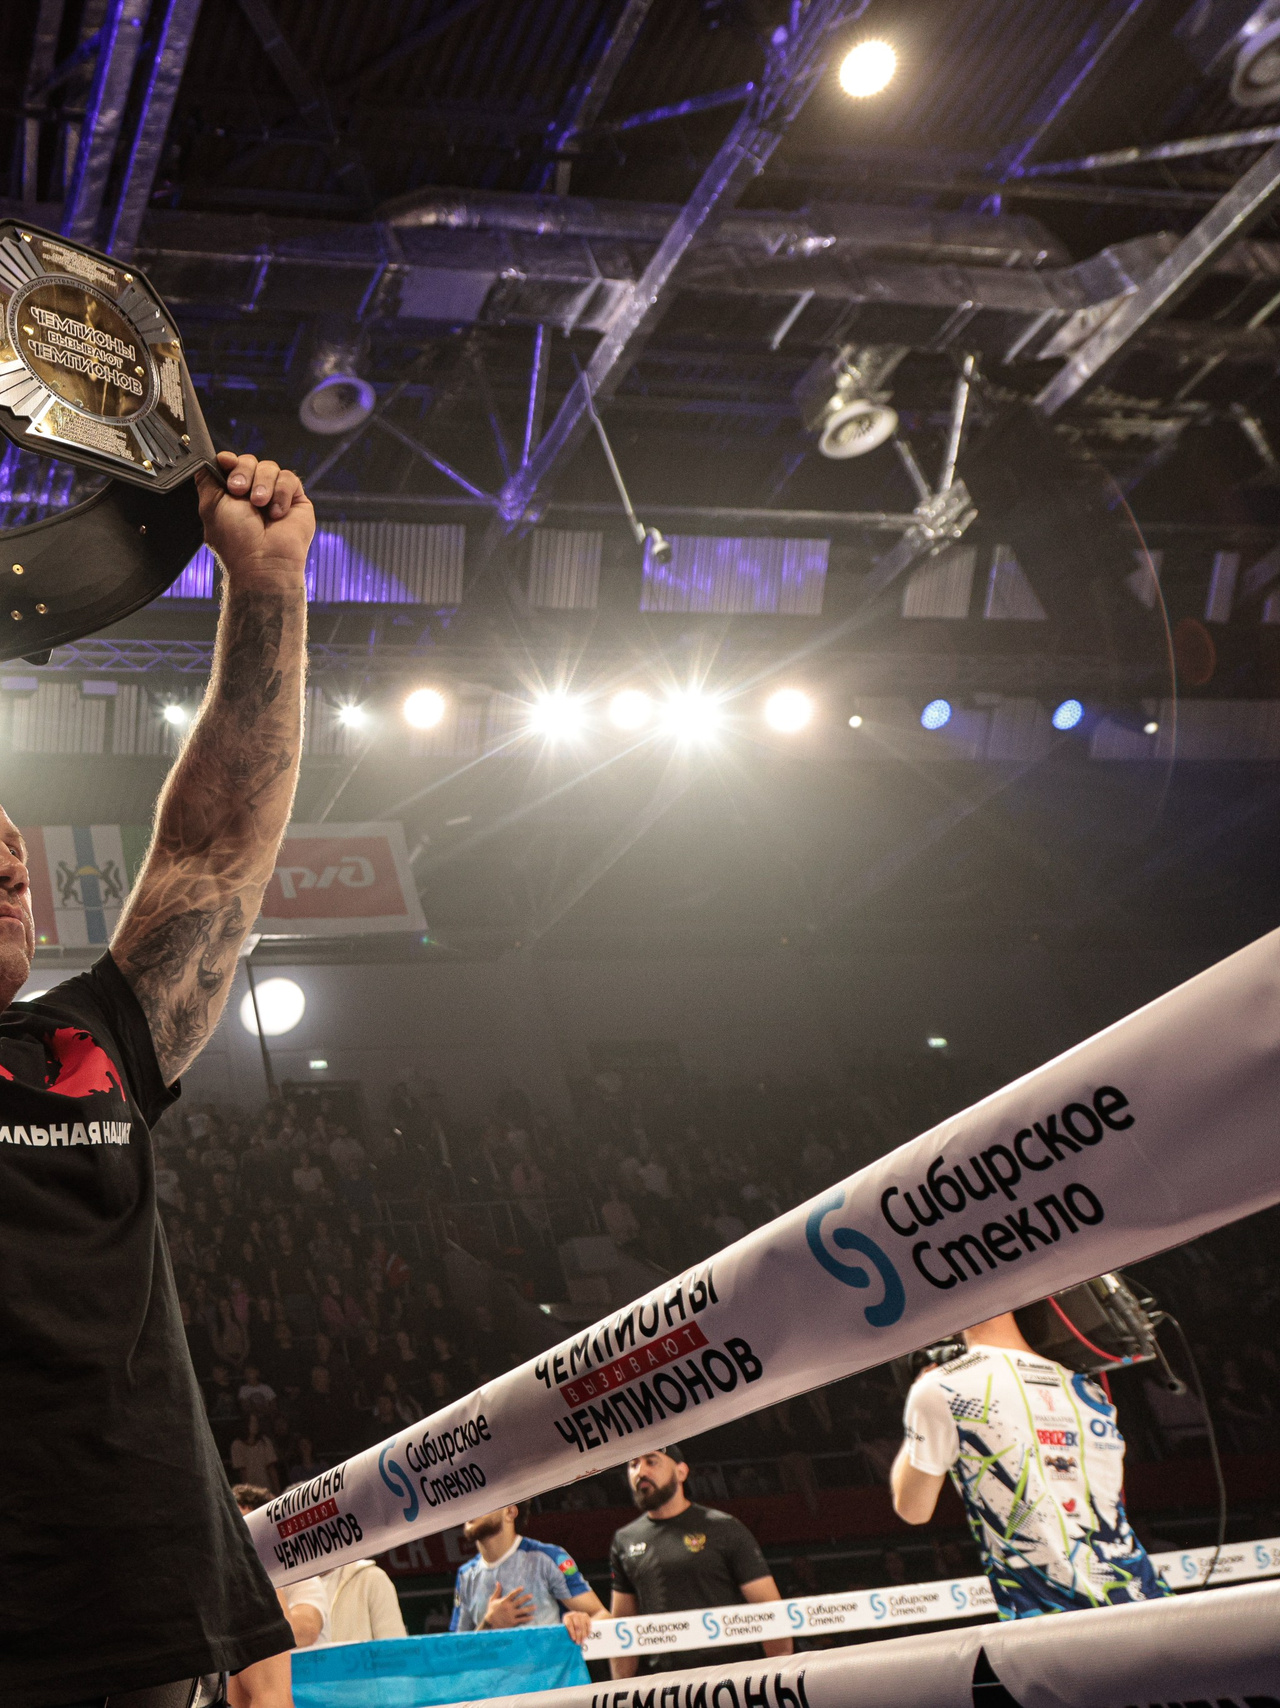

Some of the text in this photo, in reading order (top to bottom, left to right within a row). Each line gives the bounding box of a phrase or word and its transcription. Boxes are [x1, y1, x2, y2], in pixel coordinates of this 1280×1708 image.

[30, 306, 136, 362] ЧЕМПИОНЫ
[48, 331, 124, 370] ВЫЗЫВАЮТ
[28, 339, 143, 396] ЧЕМПИОНОВ
[880, 1085, 1135, 1237] Сибирское
[912, 1183, 1105, 1290] Стекло
[535, 1262, 719, 1390] ЧЕМПИОНЫ
[567, 1328, 697, 1403] ВЫЗЫВАЮТ
[553, 1337, 763, 1453] ЧЕМПИОНОВ
[405, 1414, 492, 1473] Сибирское
[266, 1462, 348, 1524] ЧЕМПИОНЫ
[420, 1462, 487, 1507] Стекло
[273, 1513, 363, 1570] ЧЕМПИОНОВ
[278, 1501, 335, 1537] ВЫЗЫВАЮТ
[722, 1610, 776, 1626] Сибирское
[807, 1601, 858, 1616] Сибирское
[809, 1614, 846, 1627] Стекло
[889, 1592, 940, 1607] Сибирское
[891, 1605, 928, 1617] Стекло
[636, 1620, 690, 1636] Сибирское
[637, 1634, 678, 1646] Стекло
[724, 1625, 763, 1638] Стекло
